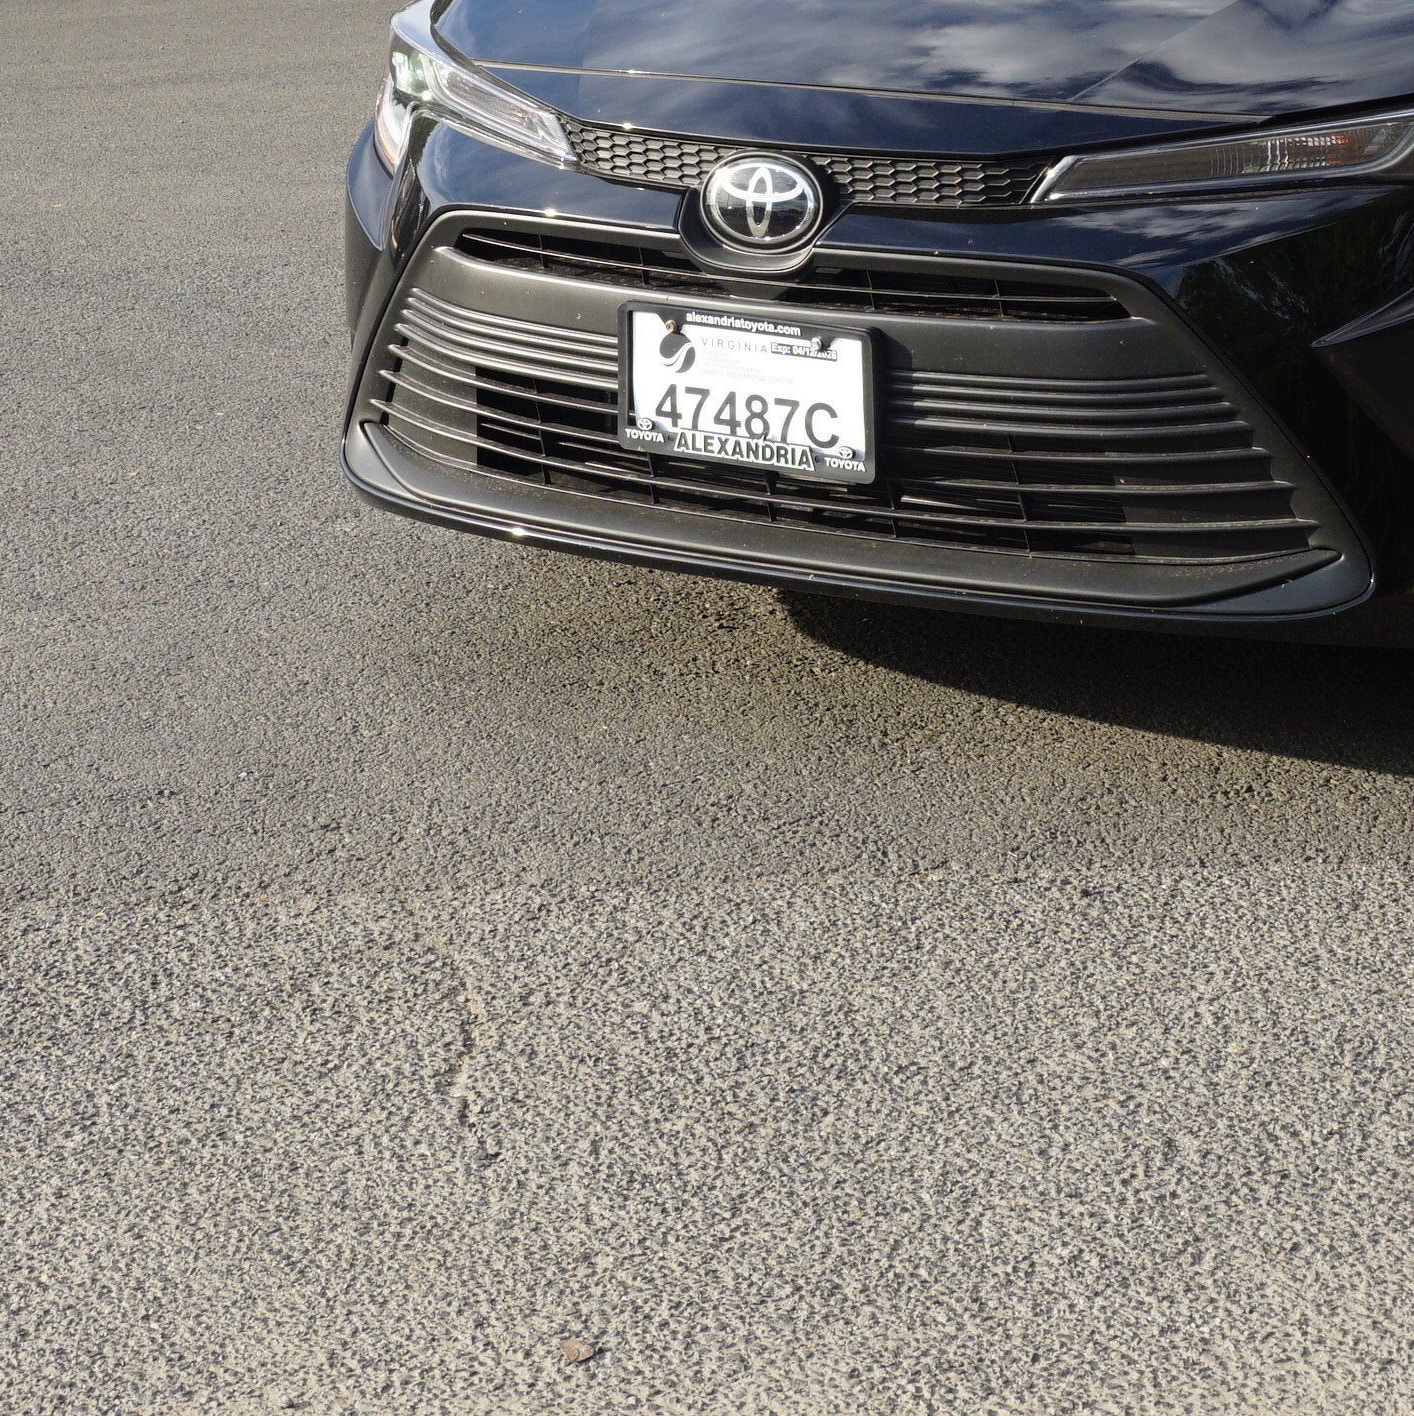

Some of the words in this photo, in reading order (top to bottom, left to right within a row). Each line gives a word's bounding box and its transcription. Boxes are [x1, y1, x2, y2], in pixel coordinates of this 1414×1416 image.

[686, 311, 802, 337] alexandriatoyota.com
[702, 337, 768, 353] VIRGINIA
[771, 342, 791, 355] Exp:
[655, 384, 840, 449] 47487C
[625, 428, 665, 443] TOYOTA
[675, 430, 814, 470] ALEXANDRIA
[824, 457, 867, 472] TOYOTA
